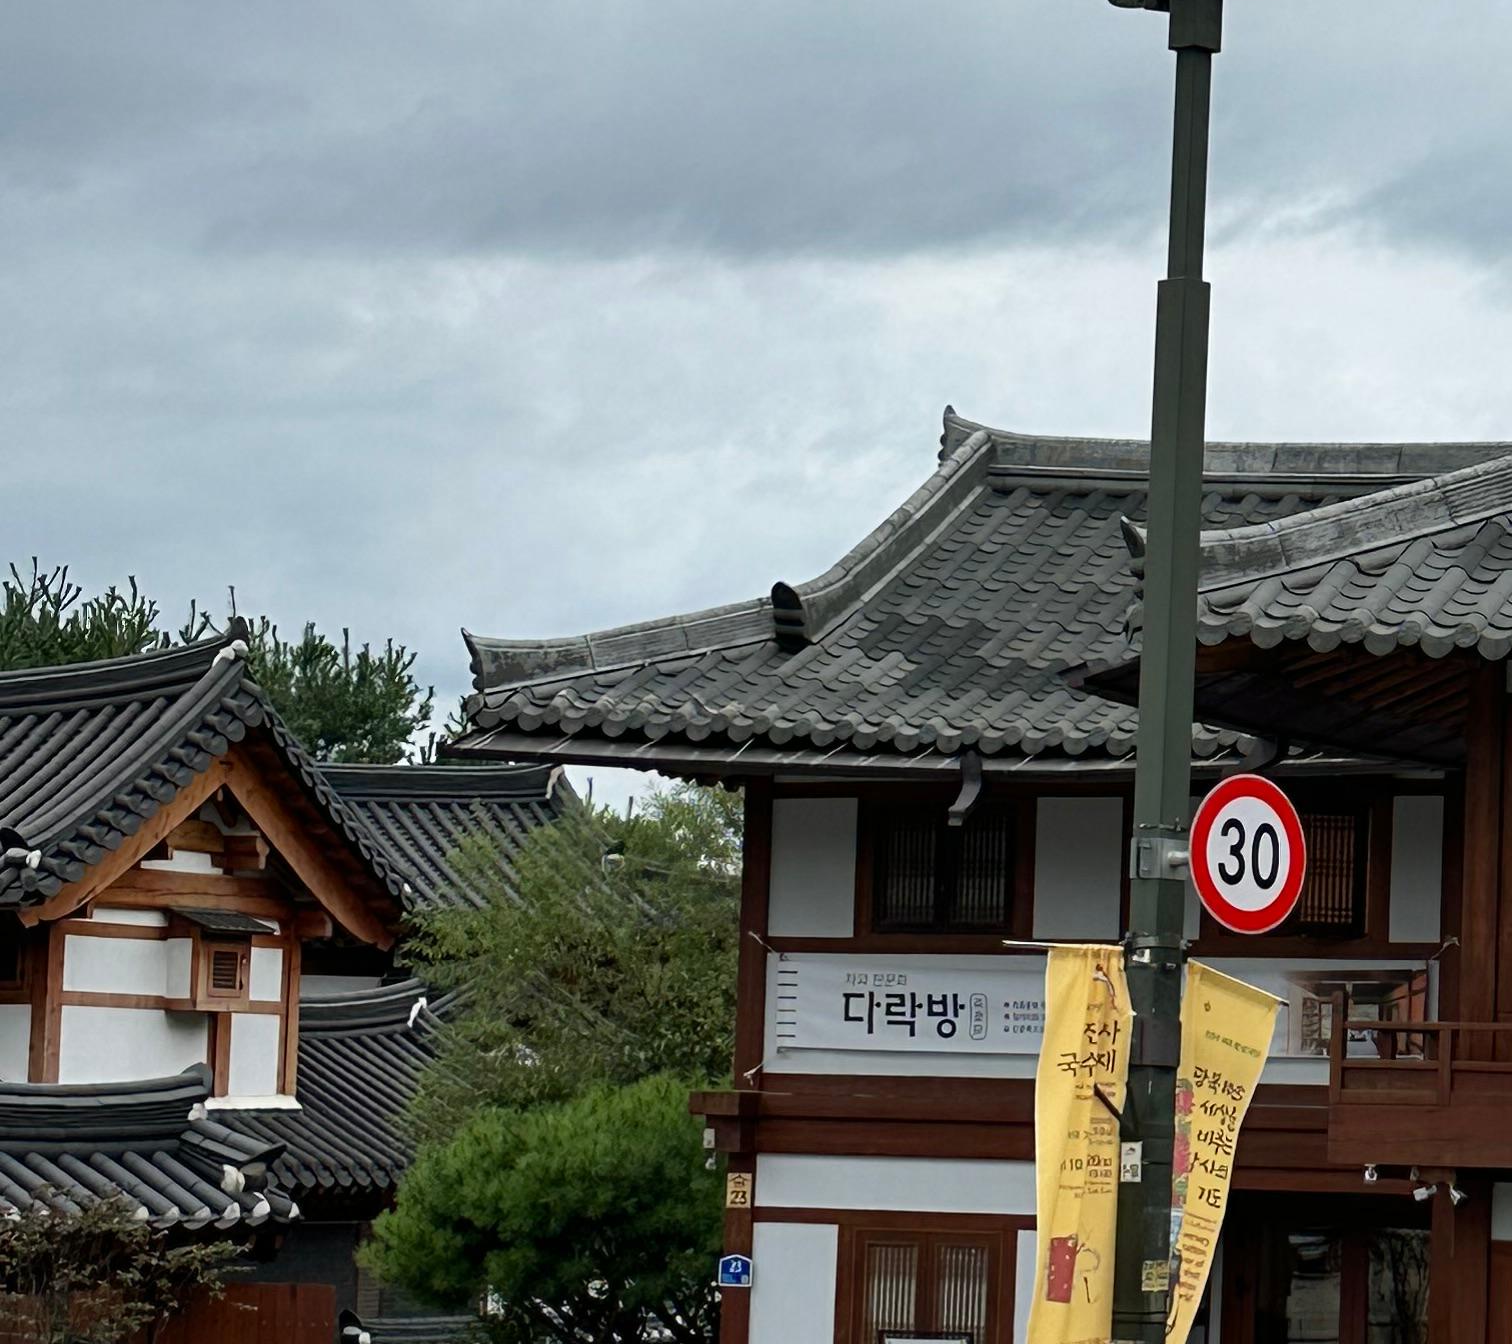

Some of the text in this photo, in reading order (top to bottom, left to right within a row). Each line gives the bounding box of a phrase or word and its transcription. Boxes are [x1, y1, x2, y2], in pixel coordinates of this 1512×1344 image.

[1218, 818, 1280, 890] 30
[842, 990, 966, 1039] 다락방
[729, 1190, 748, 1205] 23
[1198, 1186, 1221, 1208] 기도
[728, 1259, 743, 1273] 23
